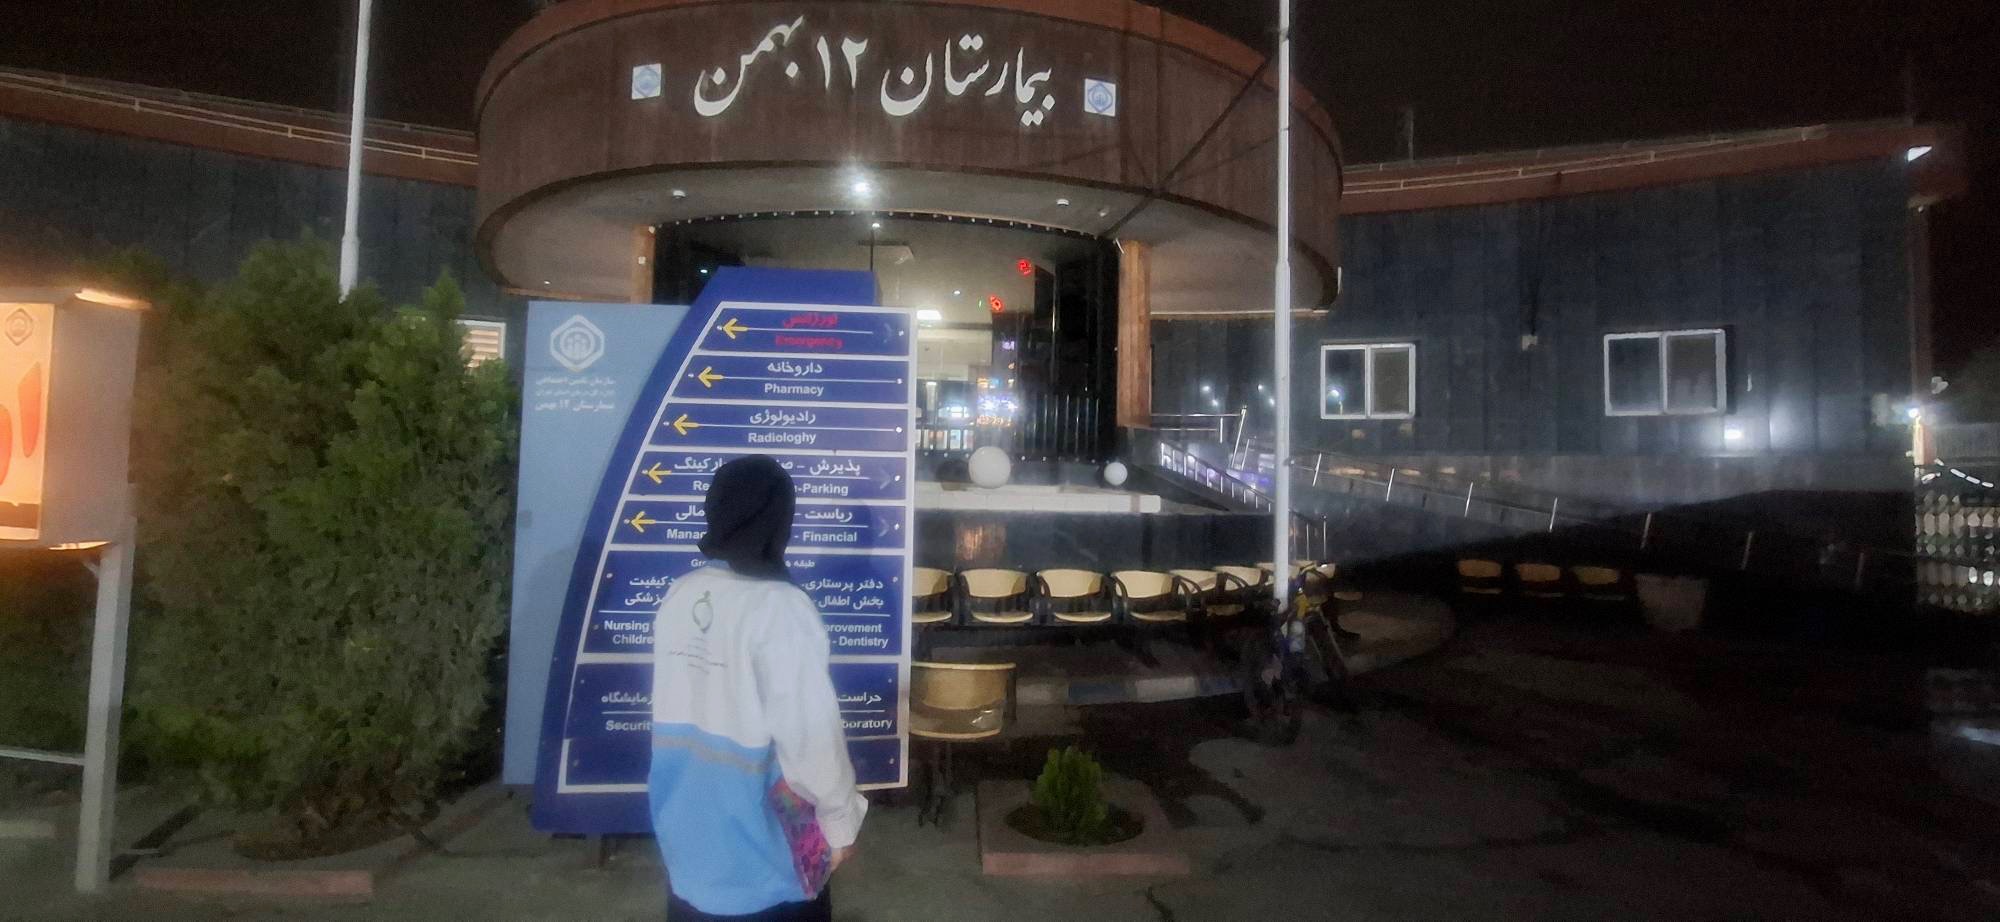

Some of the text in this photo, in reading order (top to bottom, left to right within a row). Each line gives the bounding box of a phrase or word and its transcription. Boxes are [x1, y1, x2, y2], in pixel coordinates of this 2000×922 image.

[693, 15, 1055, 126] بیمارستان ۱۲ بهمن
[767, 361, 823, 377] داروخانه
[764, 383, 824, 397] Pharmacy
[749, 409, 817, 426] رادیولوژی
[747, 431, 817, 445] Radiologhy
[674, 456, 724, 473] ارکینگ
[809, 459, 861, 477] پذیرش
[804, 508, 853, 523] ریاست
[802, 531, 858, 543] Financial
[629, 575, 668, 589] کیفیت
[855, 579, 885, 592] دفتر
[624, 592, 663, 607] زشکی
[818, 595, 885, 611] بخش اطفال
[604, 619, 650, 633] Nursing
[838, 635, 890, 649] Dentistry
[838, 691, 882, 705] حراست
[606, 719, 652, 731] Securit
